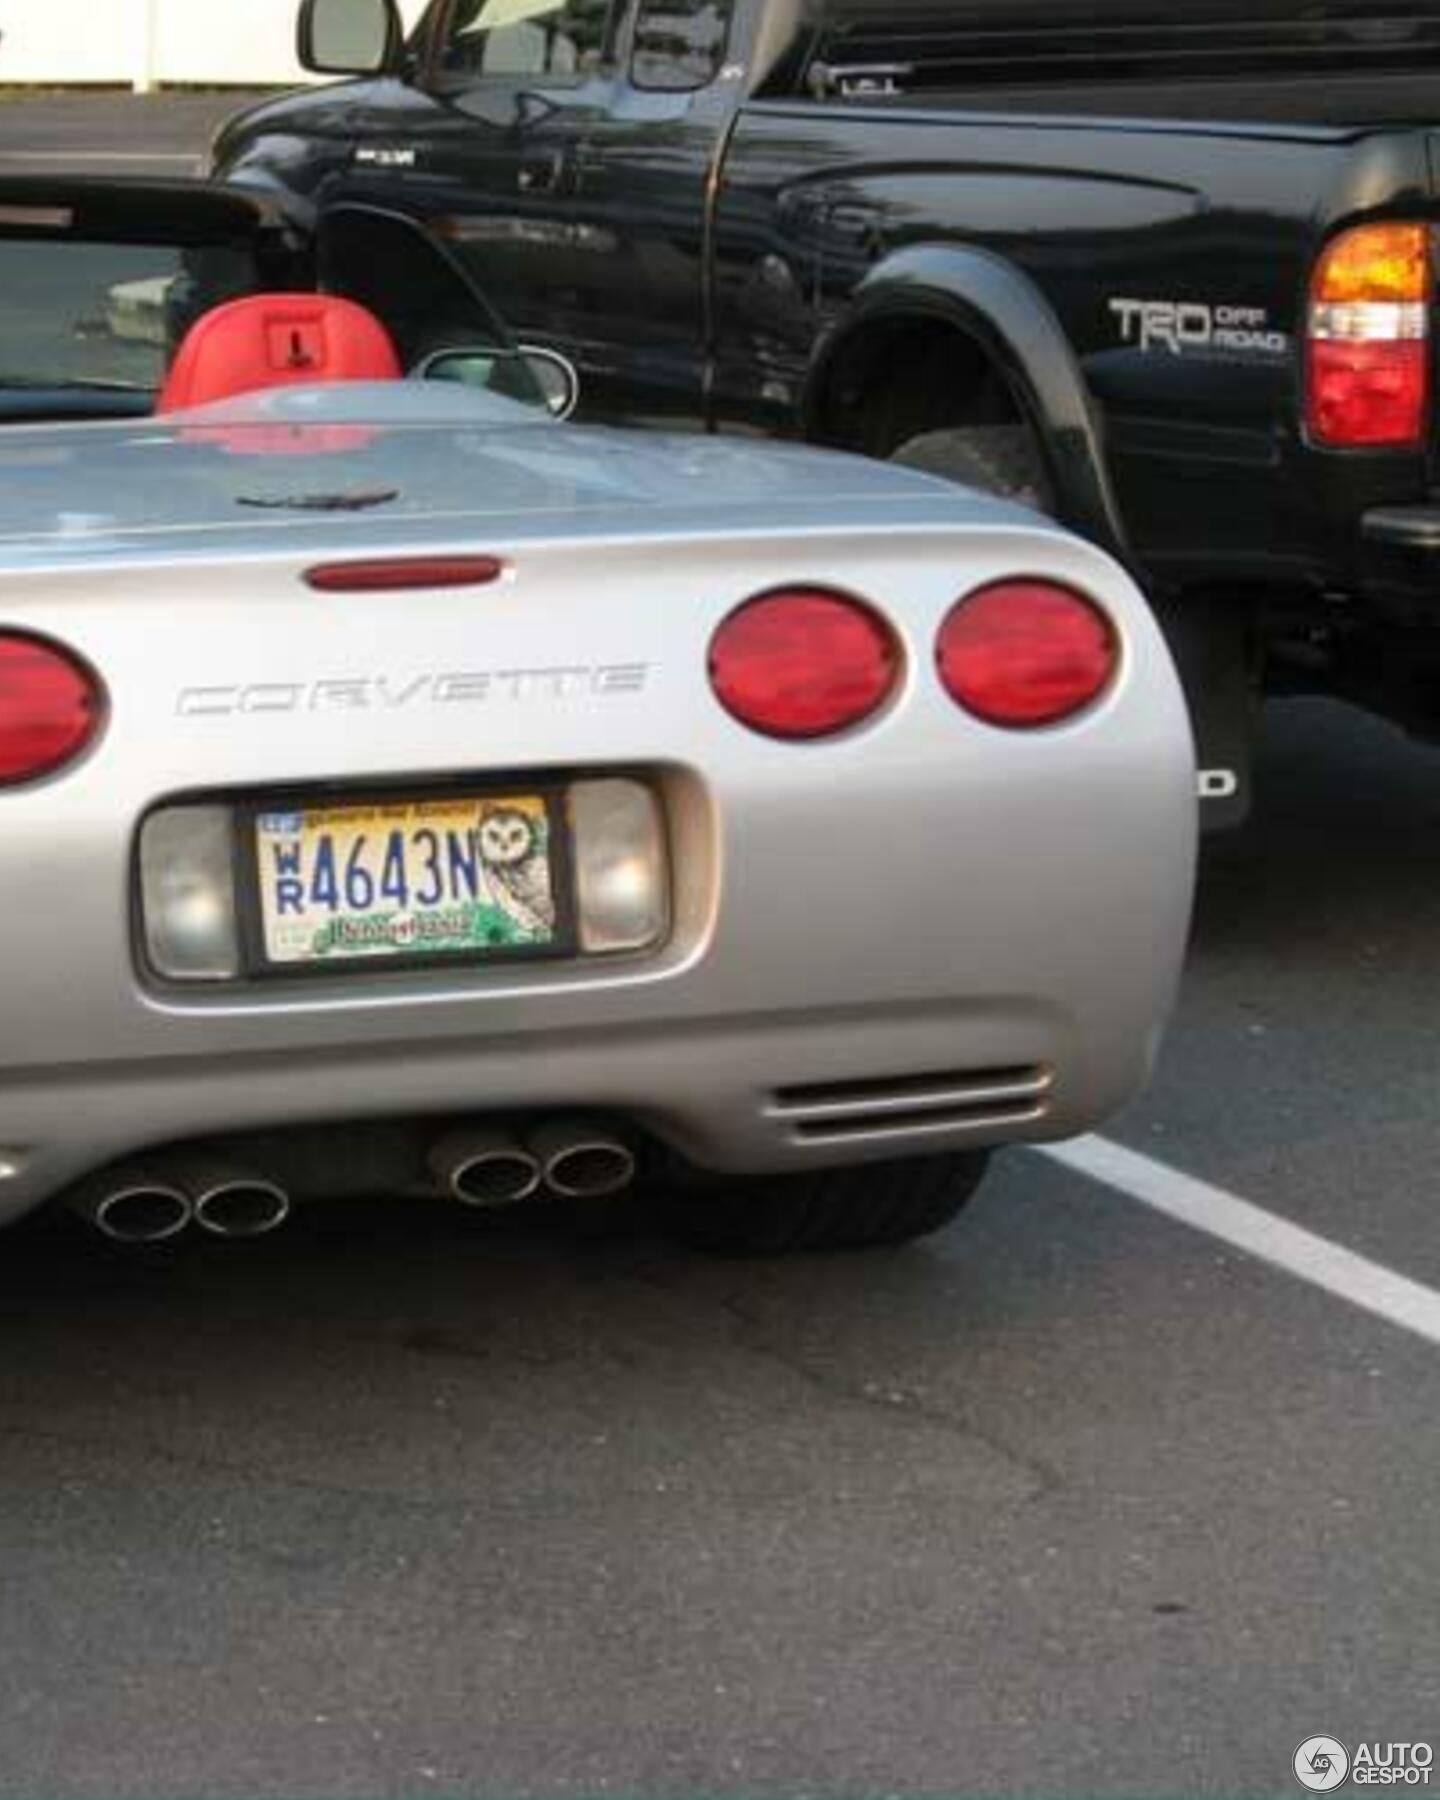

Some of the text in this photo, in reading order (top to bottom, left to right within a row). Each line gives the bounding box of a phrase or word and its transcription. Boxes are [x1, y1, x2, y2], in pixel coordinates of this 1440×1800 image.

[1109, 298, 1210, 353] TRD
[1215, 305, 1266, 326] OFF
[1215, 329, 1287, 351] ROAD
[174, 663, 653, 717] CORVETTE
[310, 828, 479, 911] 4643N
